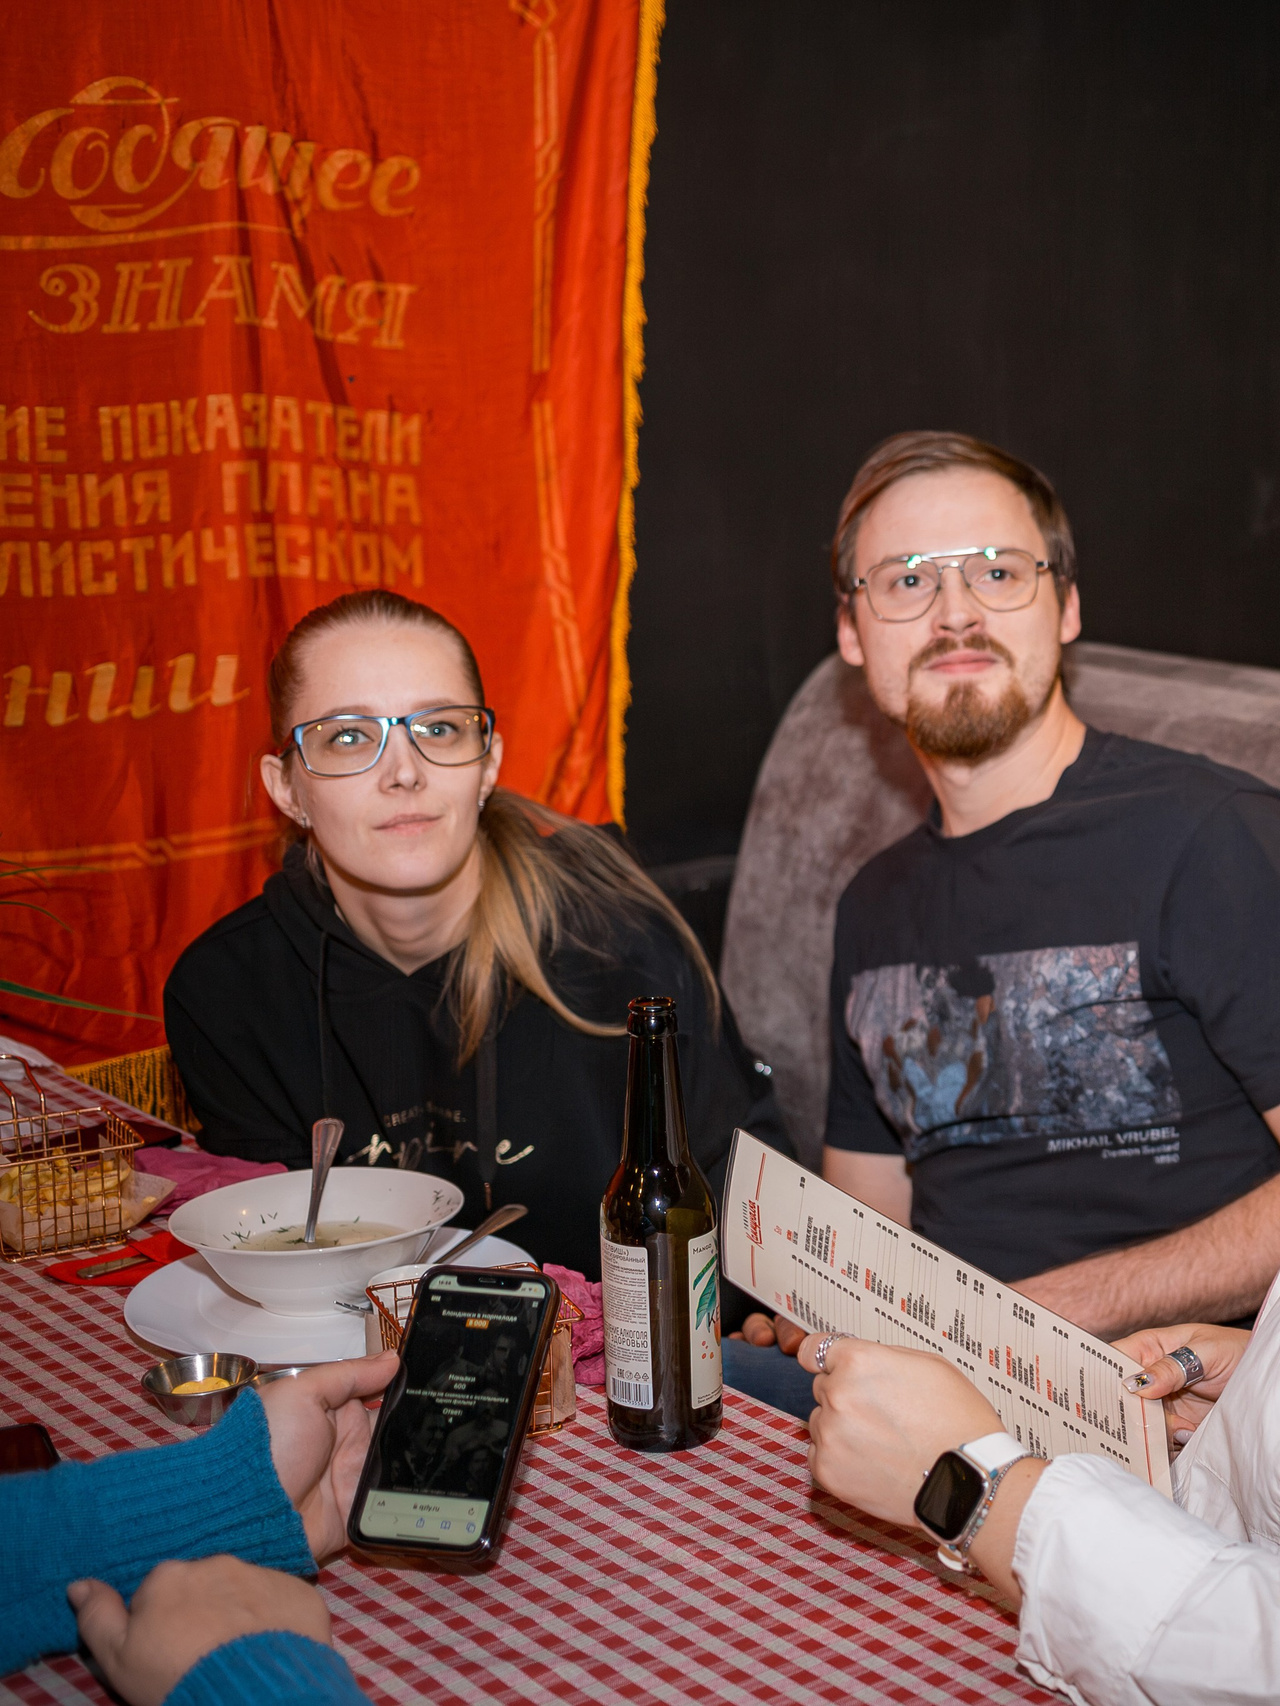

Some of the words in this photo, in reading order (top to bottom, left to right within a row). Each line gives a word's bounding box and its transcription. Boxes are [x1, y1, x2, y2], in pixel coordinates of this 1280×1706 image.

[28, 254, 418, 350] ЗНАМЯ
[98, 392, 422, 467] ПОКАЗАТЕЛИ
[221, 459, 423, 527] ПЛАНА
[1047, 1135, 1112, 1152] MIKHAIL
[1115, 1126, 1180, 1144] VRUBEL
